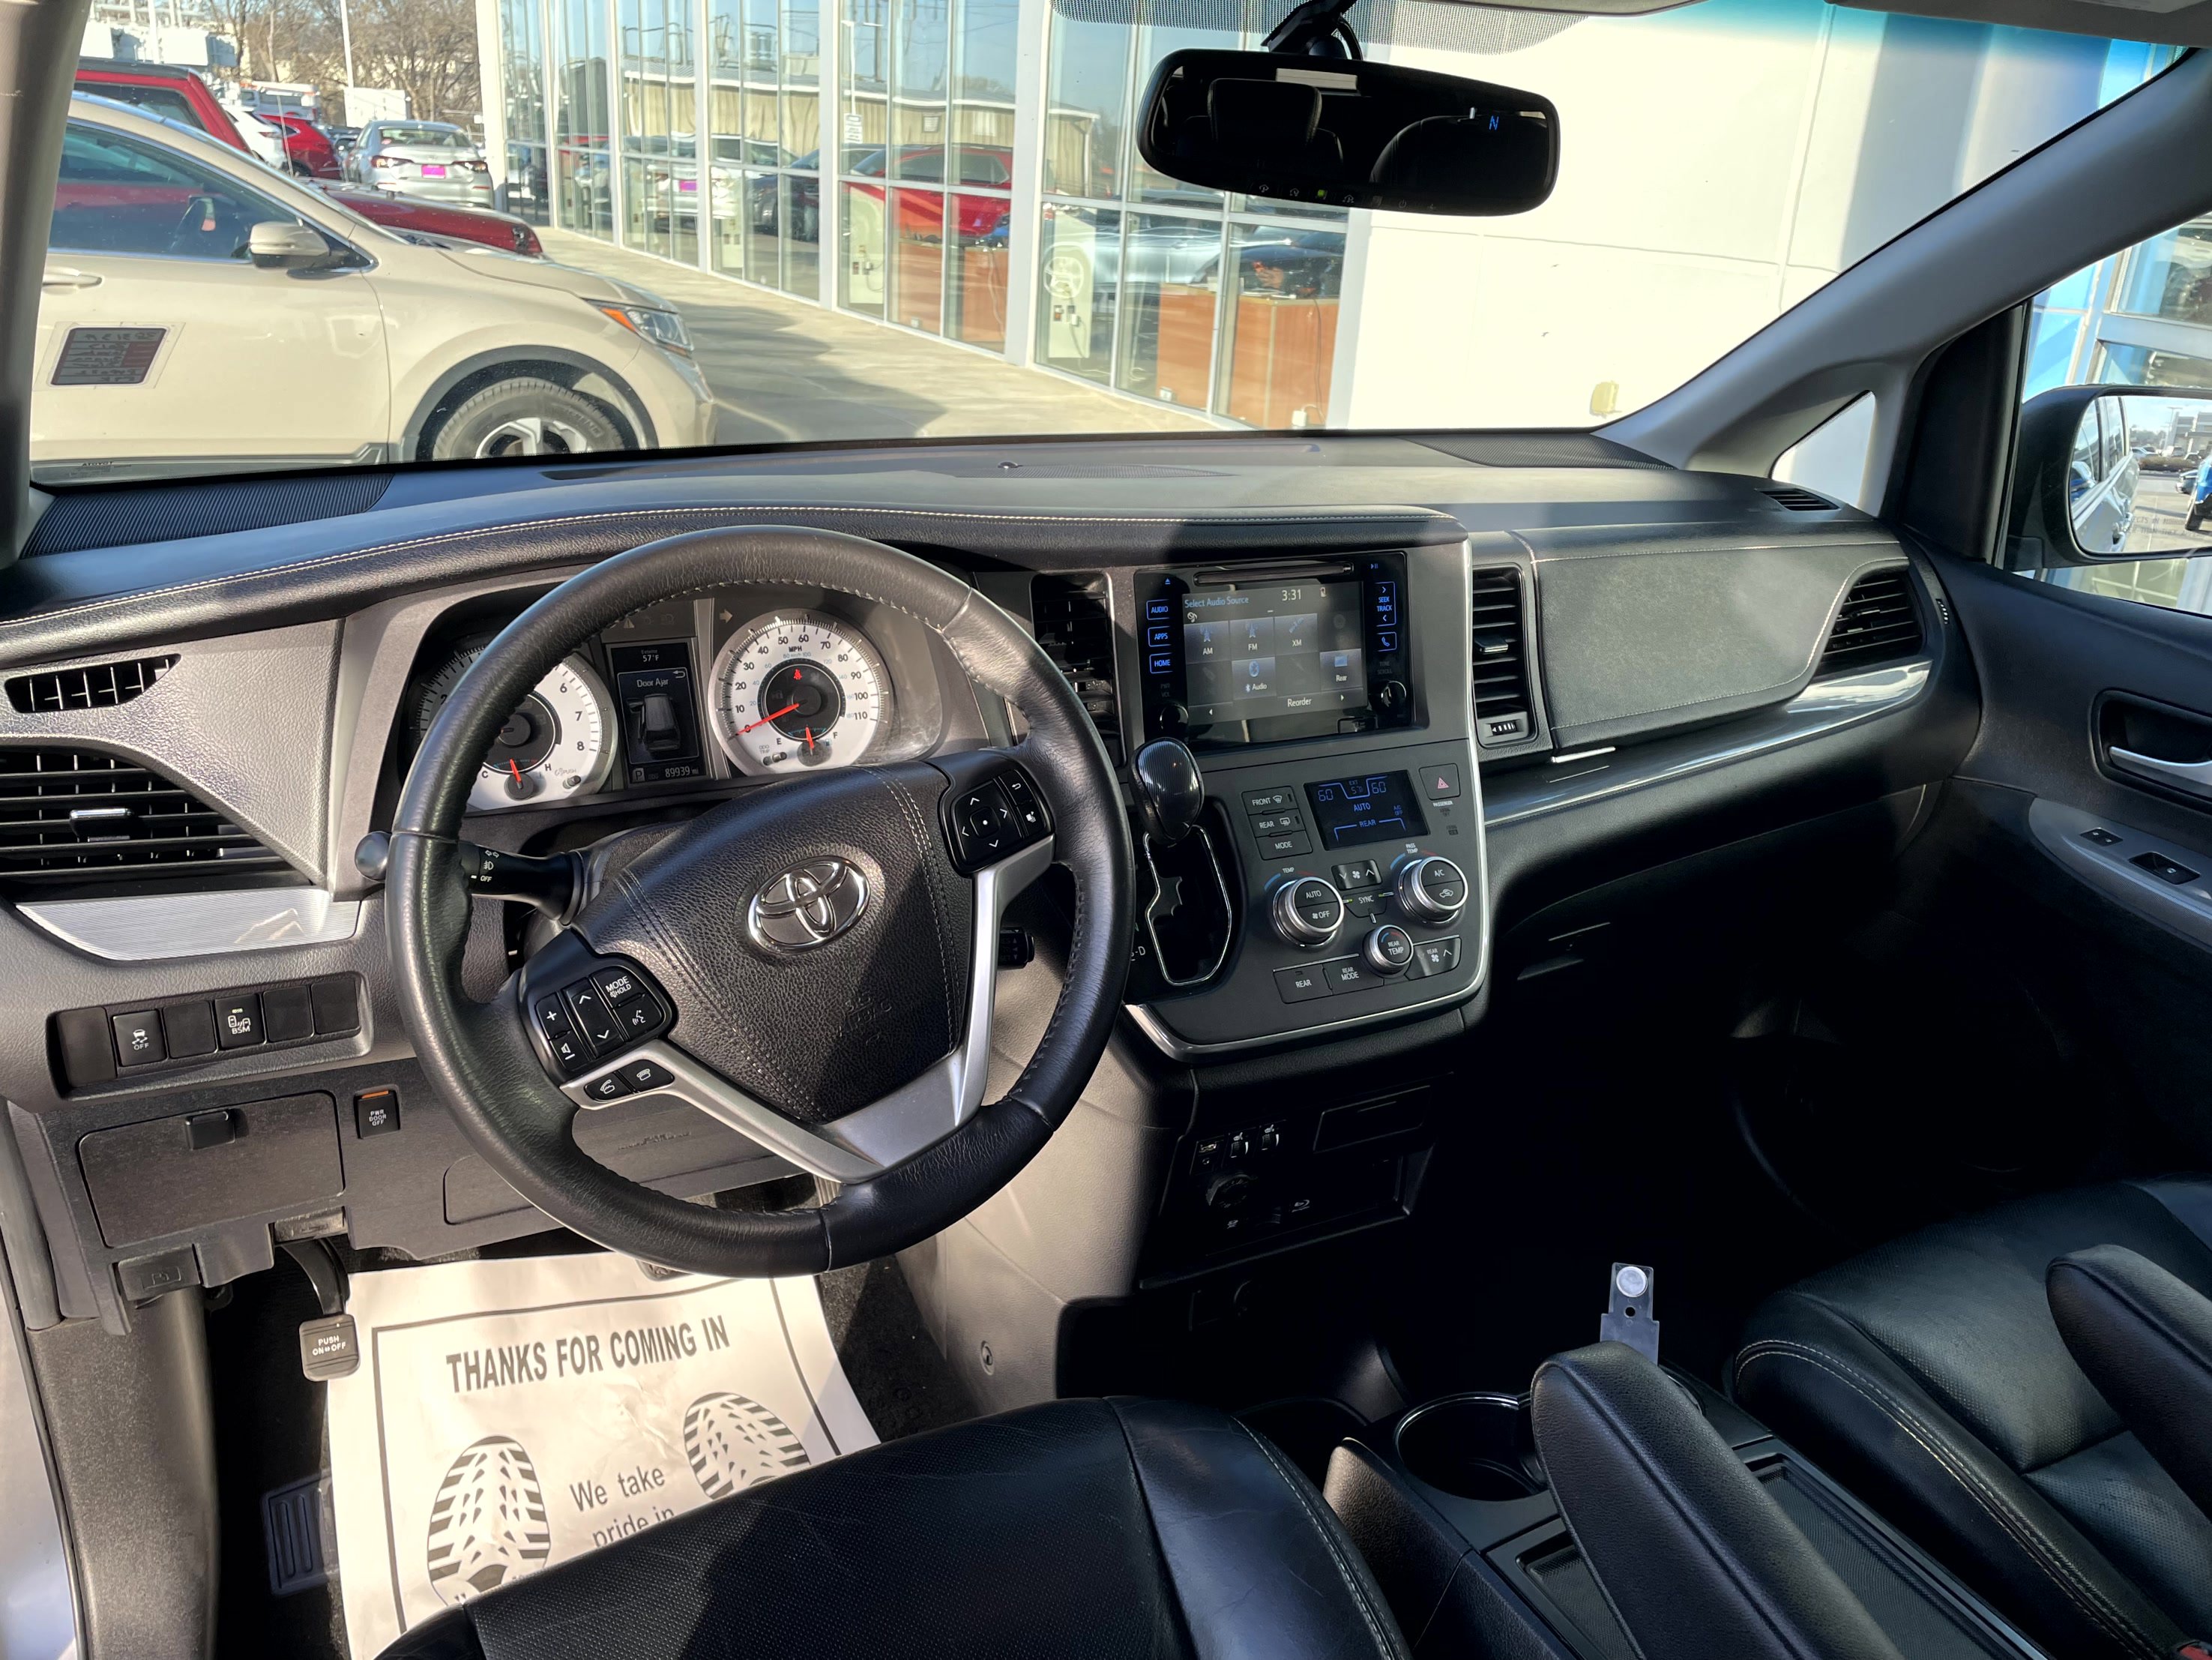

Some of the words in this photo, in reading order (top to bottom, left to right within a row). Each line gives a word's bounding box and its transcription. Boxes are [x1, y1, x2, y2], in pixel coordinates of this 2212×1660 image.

[1489, 115, 1499, 130] N
[1282, 589, 1301, 601] 3:31
[1184, 599, 1205, 608] Select
[1207, 597, 1226, 607] Audio
[1226, 595, 1249, 605] Source
[1151, 606, 1169, 614] AUDIO
[778, 636, 789, 645] 50
[798, 634, 809, 643] 60
[1154, 632, 1168, 640] APPS
[820, 641, 831, 650] 70
[757, 646, 768, 655] 40
[837, 654, 849, 662] 80
[743, 662, 755, 670] 30
[1154, 659, 1171, 667] HOME
[851, 671, 861, 680] 90
[637, 679, 654, 688] Door
[655, 678, 669, 686] Ajar
[735, 682, 747, 690] 20
[559, 683, 567, 694] 6
[855, 691, 868, 700] 100
[1287, 697, 1312, 707] Reorder
[735, 705, 745, 713] 10
[575, 711, 582, 721] 7
[855, 712, 868, 720] 110
[576, 741, 585, 751] 8
[544, 763, 552, 772] H
[665, 766, 690, 778] 89939
[481, 770, 489, 778] C
[1371, 781, 1387, 794] 60
[1318, 789, 1333, 802] 60
[1252, 797, 1271, 806] FRONT
[1354, 802, 1371, 812] AUTO
[1259, 821, 1275, 829] REAR
[1359, 820, 1376, 828] REAR
[1275, 841, 1293, 849] MODE
[1434, 869, 1445, 877] A/C
[1306, 890, 1322, 899] AUTO
[1358, 894, 1374, 903] SYNC
[1319, 910, 1330, 919] OFF
[1387, 946, 1404, 956] TEMP
[1341, 972, 1359, 981] MODE
[606, 975, 630, 993] MODE
[1295, 979, 1312, 989] REAR
[615, 983, 632, 996] HOLD
[232, 1026, 250, 1035] BSM
[133, 1042, 149, 1050] OFF
[369, 1113, 387, 1122] DOOR
[318, 1335, 340, 1347] PUSH
[445, 1341, 548, 1393] THANKS
[555, 1335, 603, 1377] FOR
[609, 1322, 698, 1368] COMING
[701, 1314, 730, 1352] IN
[569, 1479, 608, 1512] We
[617, 1465, 666, 1498] take
[592, 1514, 649, 1548] pride
